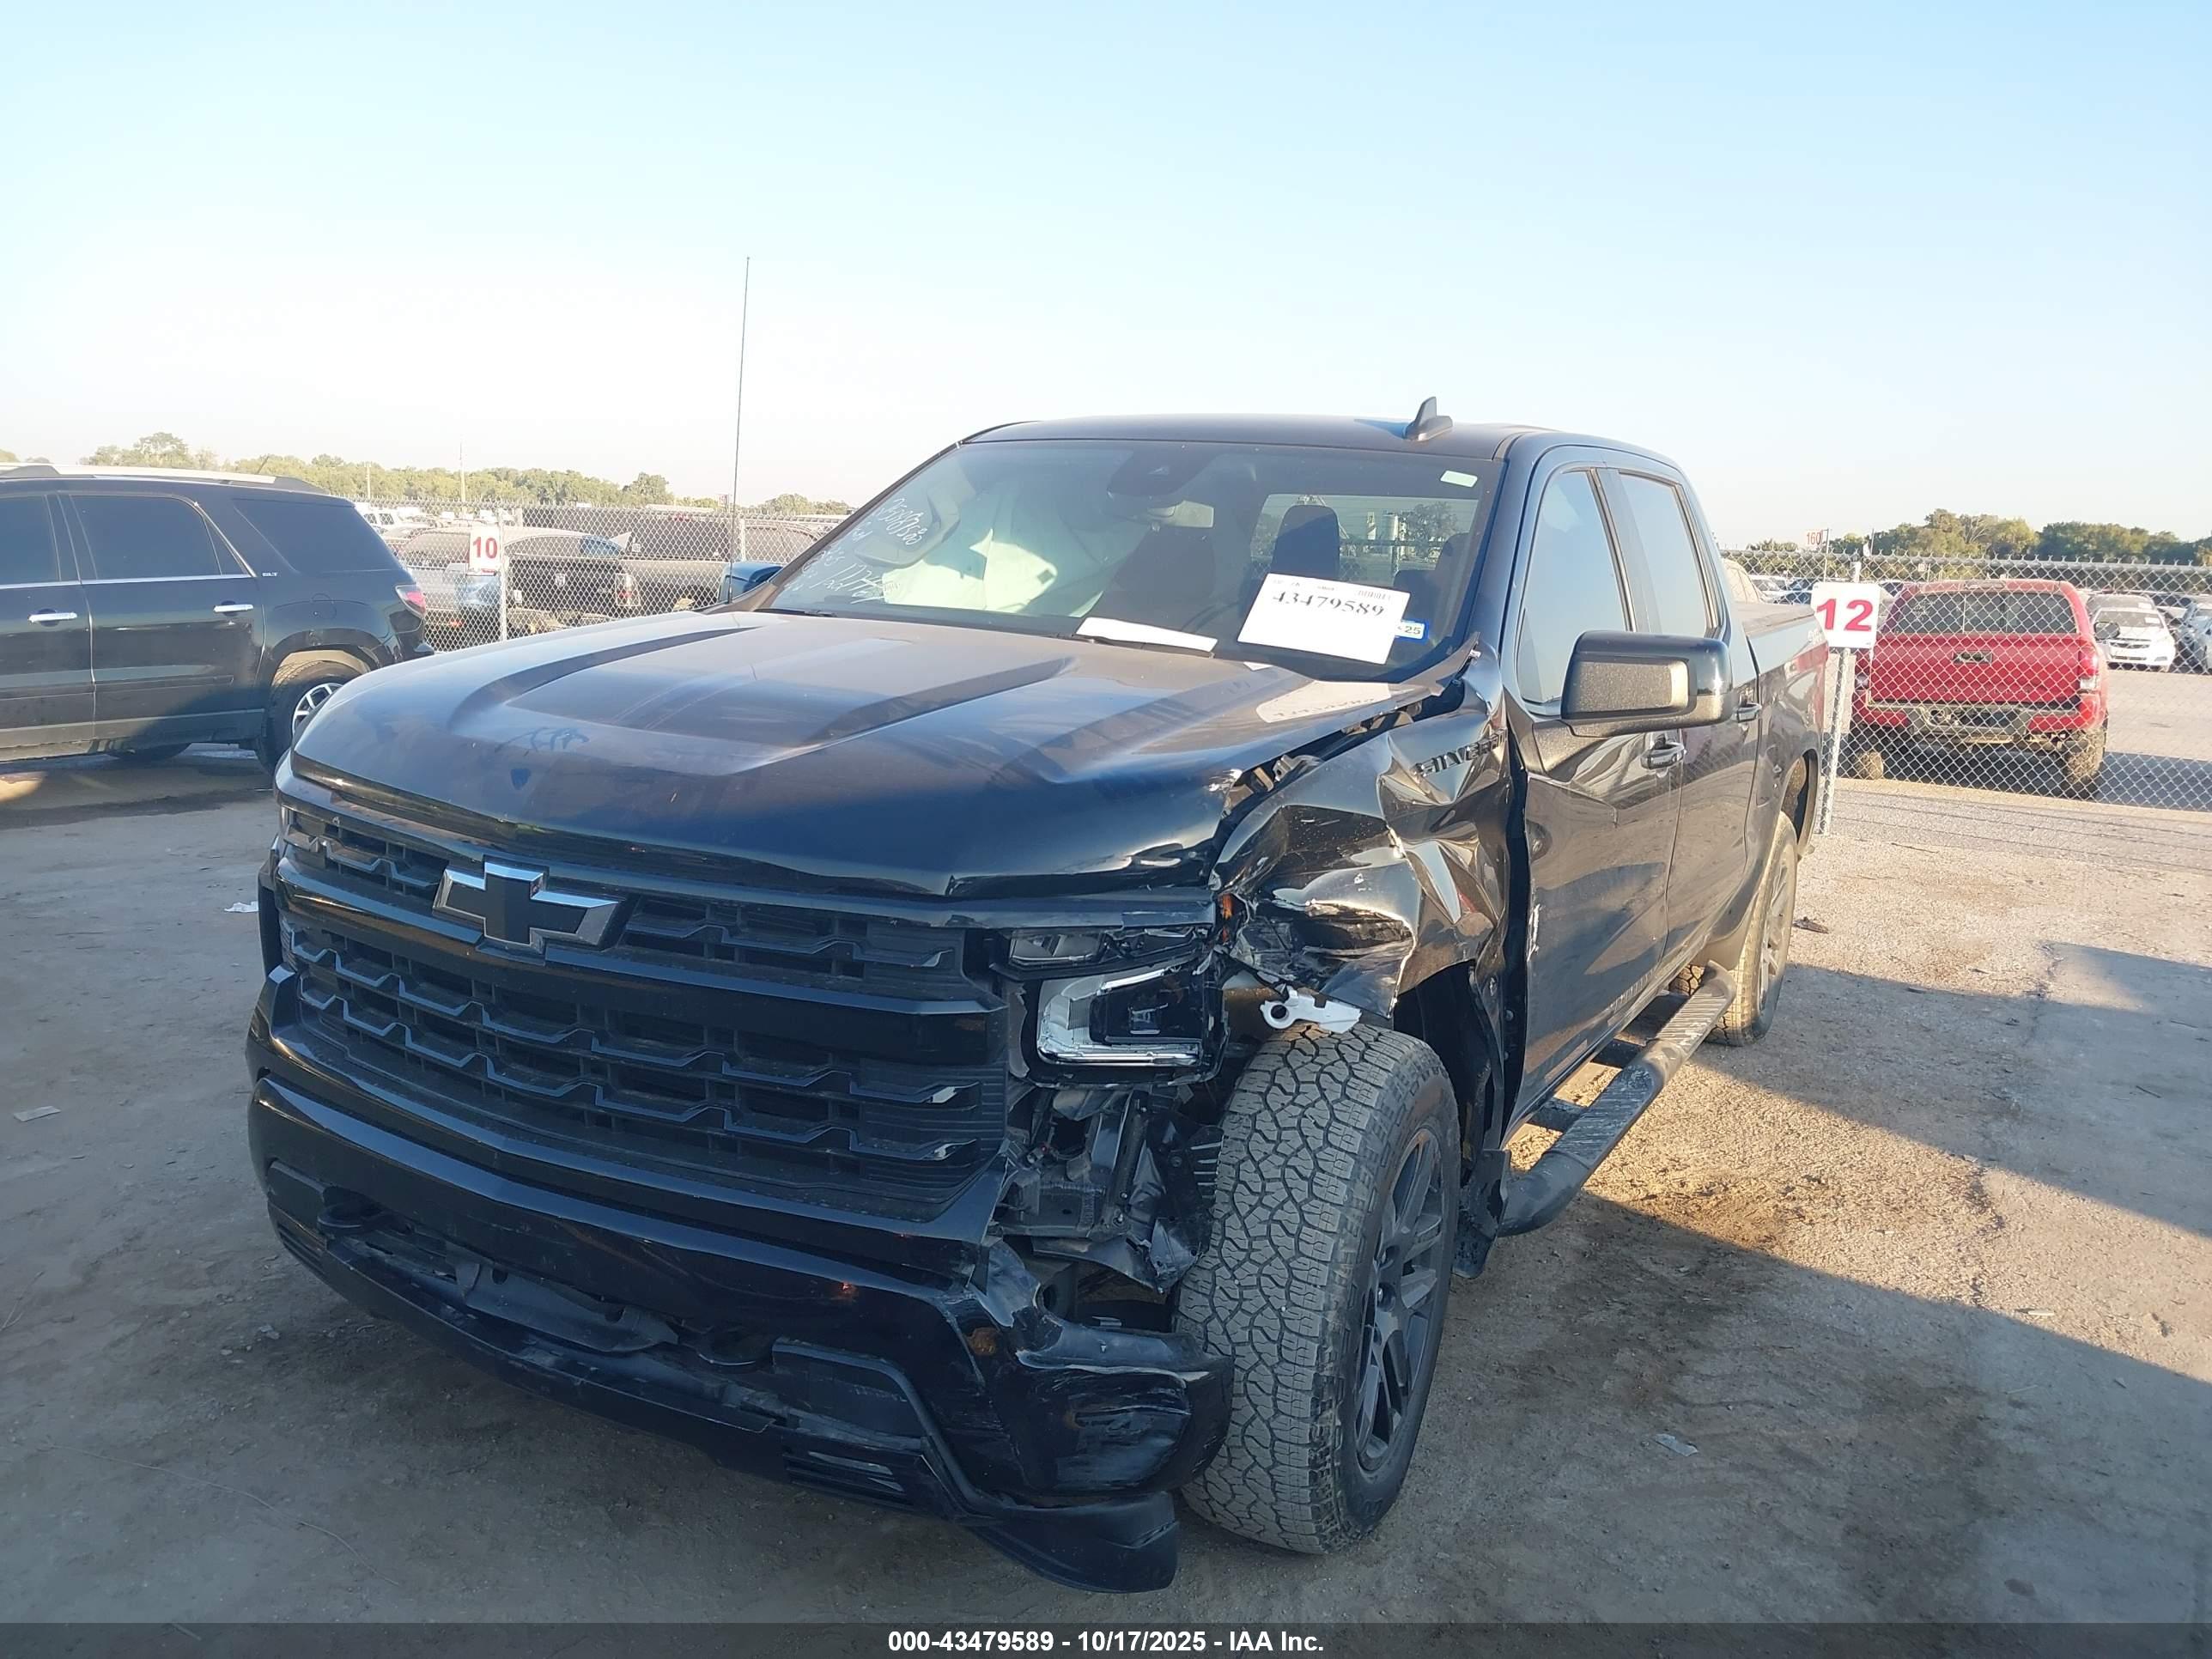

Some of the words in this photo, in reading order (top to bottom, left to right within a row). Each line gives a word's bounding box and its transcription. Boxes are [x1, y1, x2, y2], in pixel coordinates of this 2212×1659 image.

[472, 536, 498, 560] 10
[1273, 591, 1385, 617] 43479589
[1816, 598, 1874, 632] 12
[1404, 625, 1421, 635] 25
